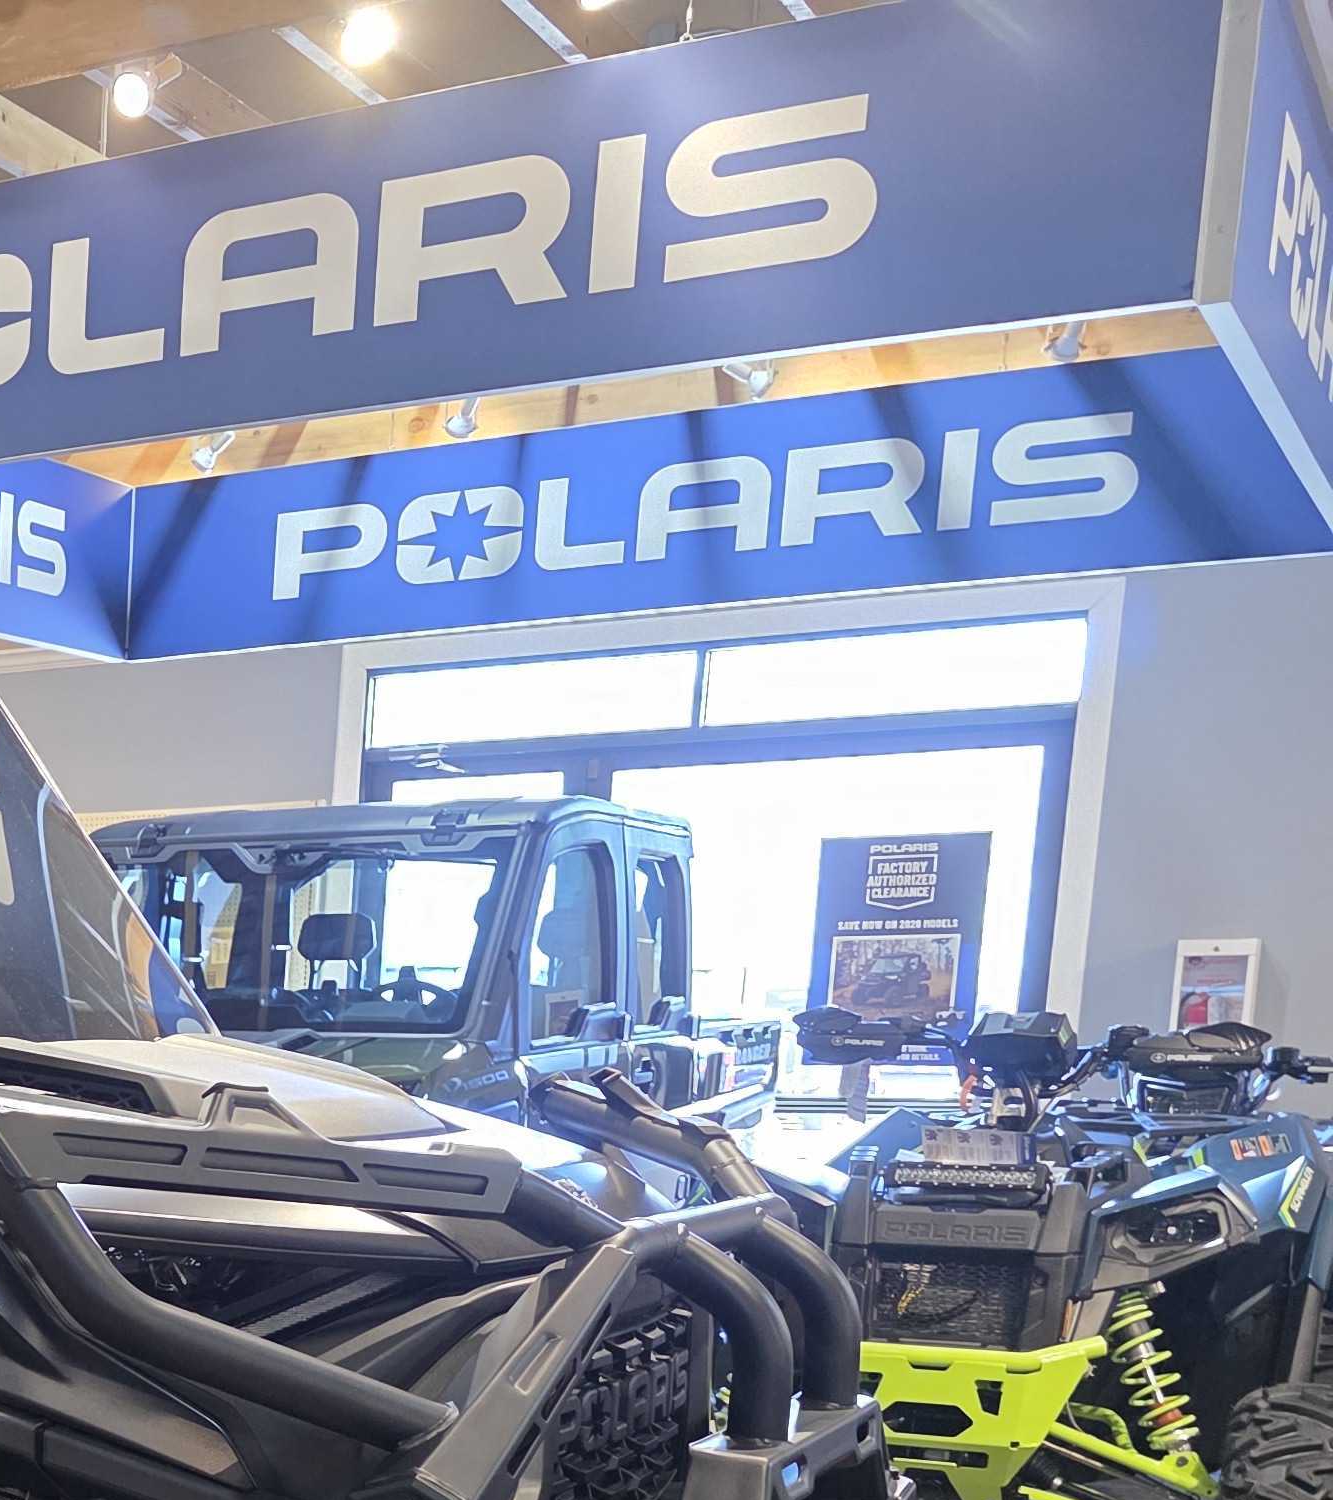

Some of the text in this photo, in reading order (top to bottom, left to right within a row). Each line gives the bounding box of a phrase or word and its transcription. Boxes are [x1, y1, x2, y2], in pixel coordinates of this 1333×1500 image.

[273, 411, 1139, 602] POLARIS
[869, 842, 939, 854] POLARIS
[877, 861, 930, 875] FACTORY
[866, 873, 937, 887] AUTHORIZED
[871, 886, 931, 899] CLEARANCE
[837, 921, 861, 931] SAVE
[862, 920, 883, 930] NOW
[923, 918, 959, 929] MODELS
[1166, 1053, 1213, 1062] POLARIS
[884, 1220, 1030, 1244] POLARIS
[556, 1350, 689, 1450] POLARIS
